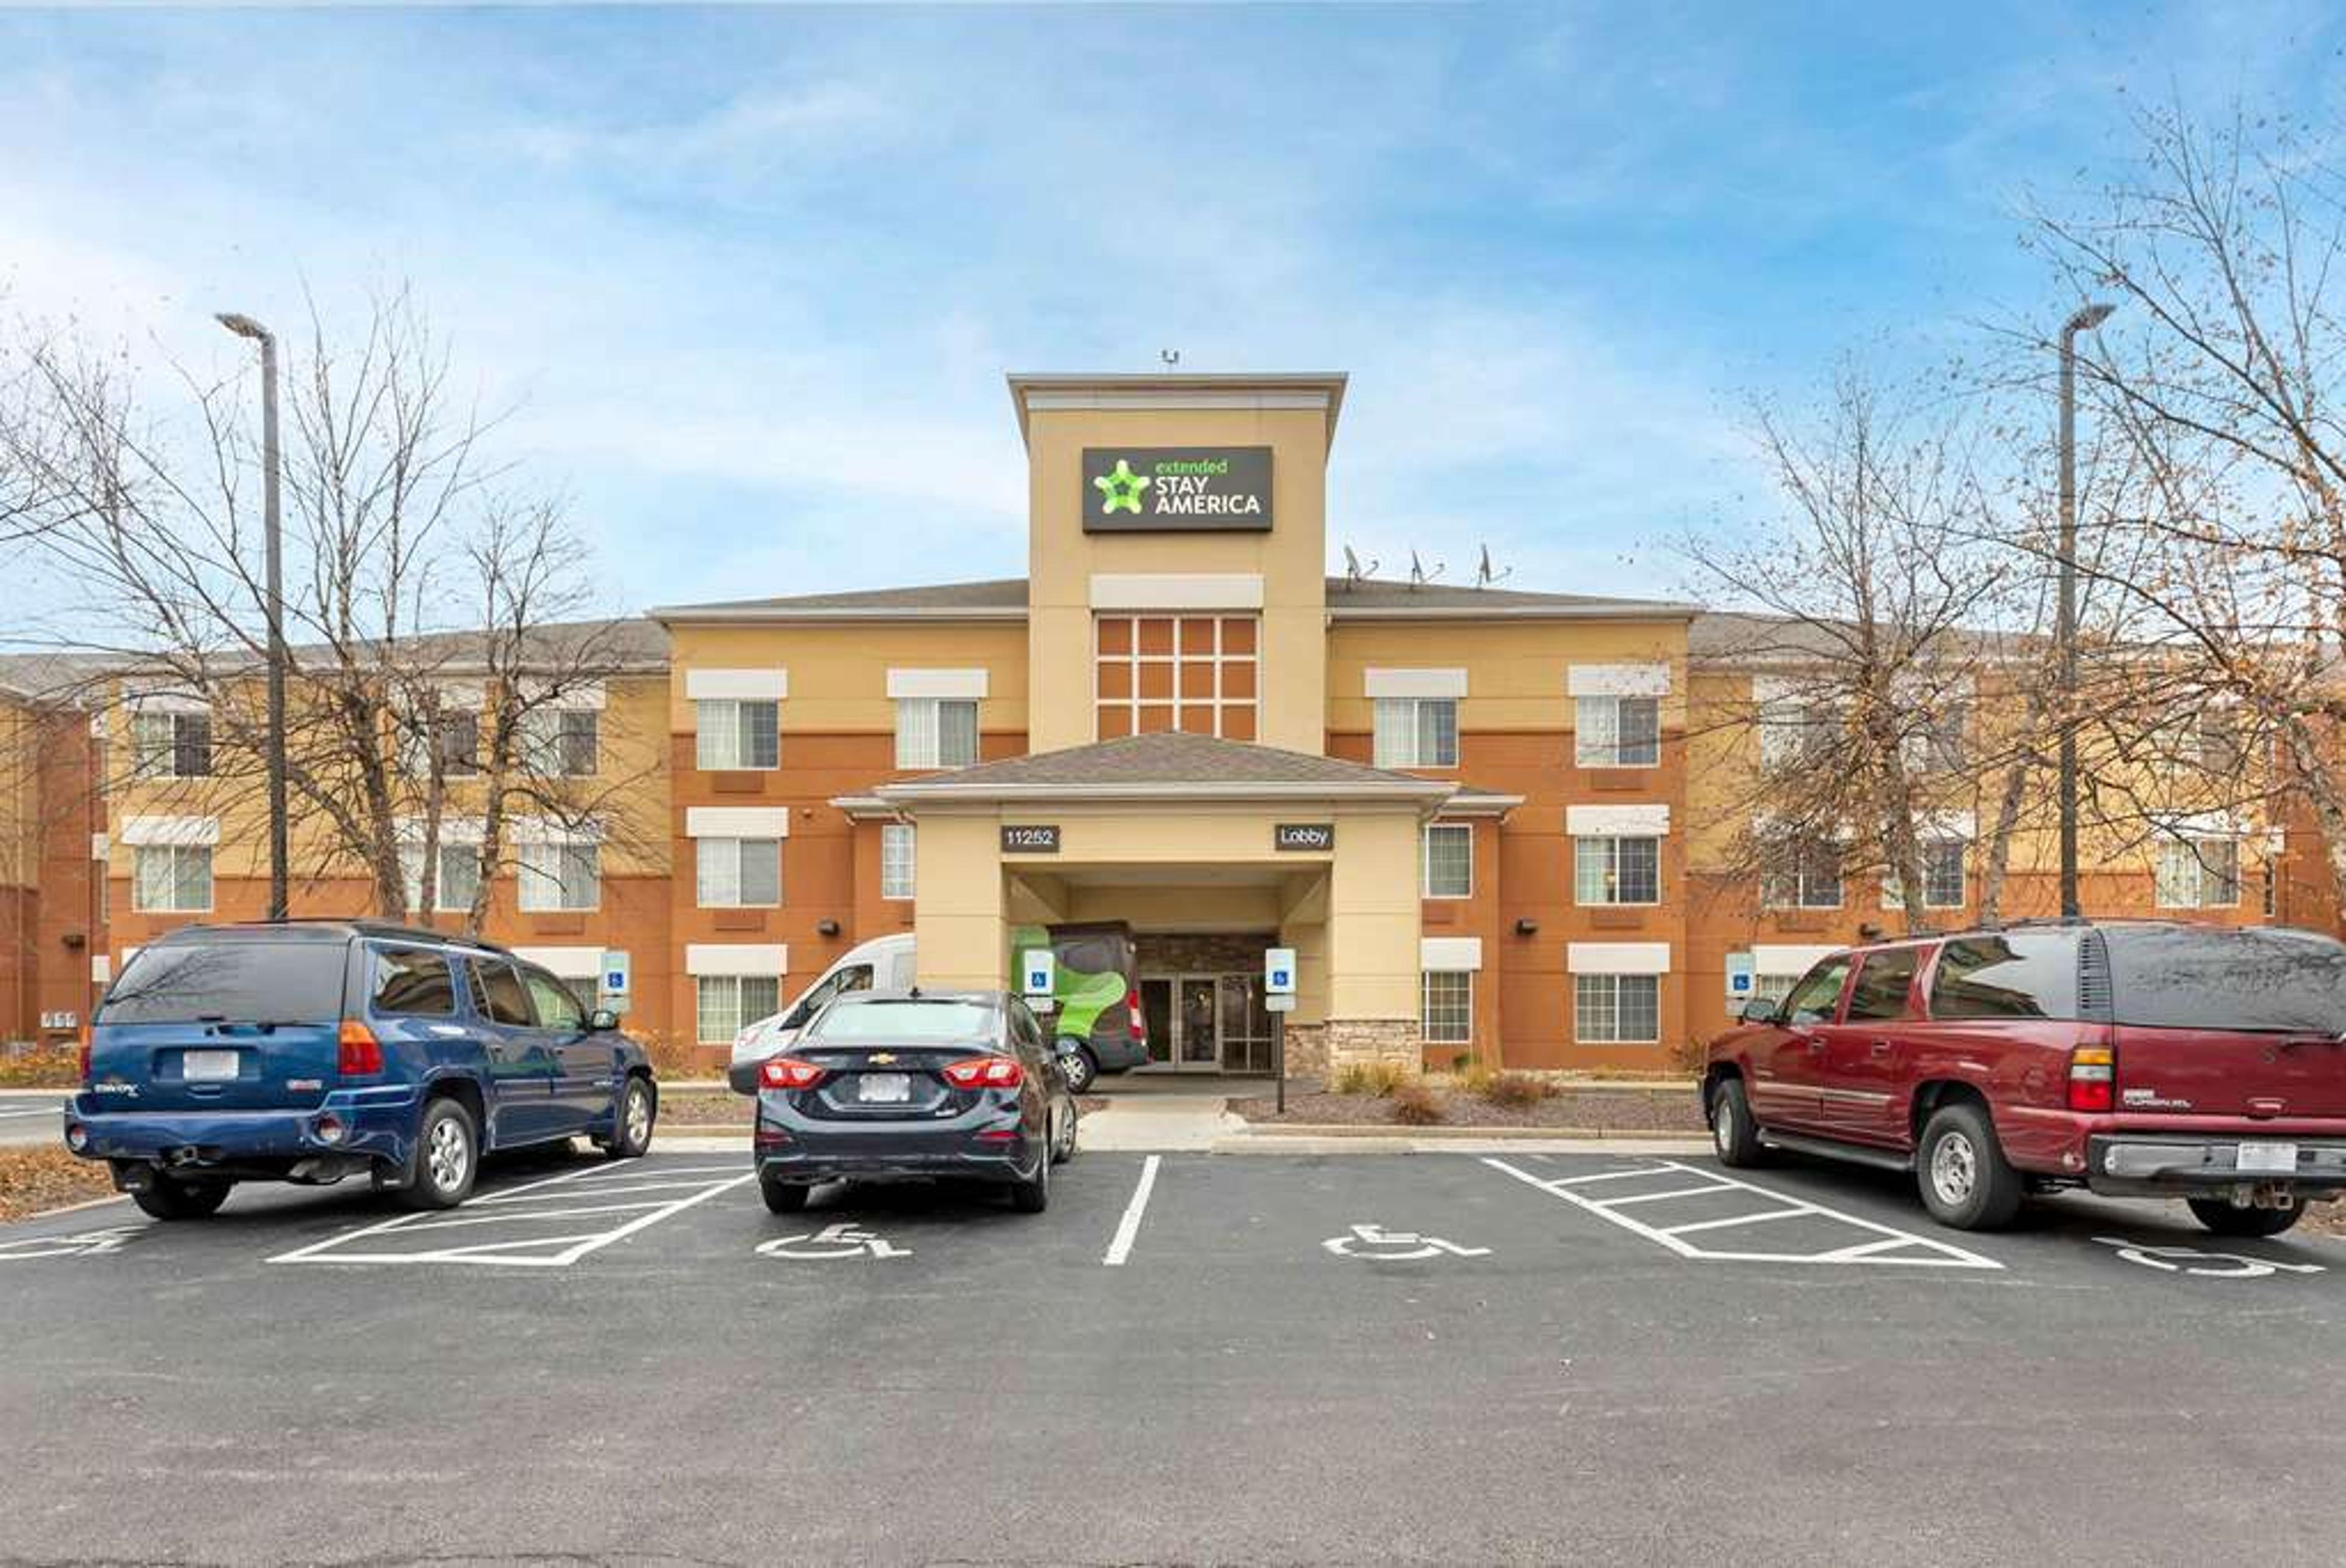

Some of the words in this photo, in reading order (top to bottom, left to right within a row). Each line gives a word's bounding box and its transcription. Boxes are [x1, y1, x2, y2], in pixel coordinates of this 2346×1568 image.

[1155, 459, 1228, 474] extended
[1155, 476, 1210, 495] STAY
[1155, 495, 1261, 514] AMERICA
[1008, 830, 1053, 844] 11252
[1281, 828, 1328, 847] Lobby
